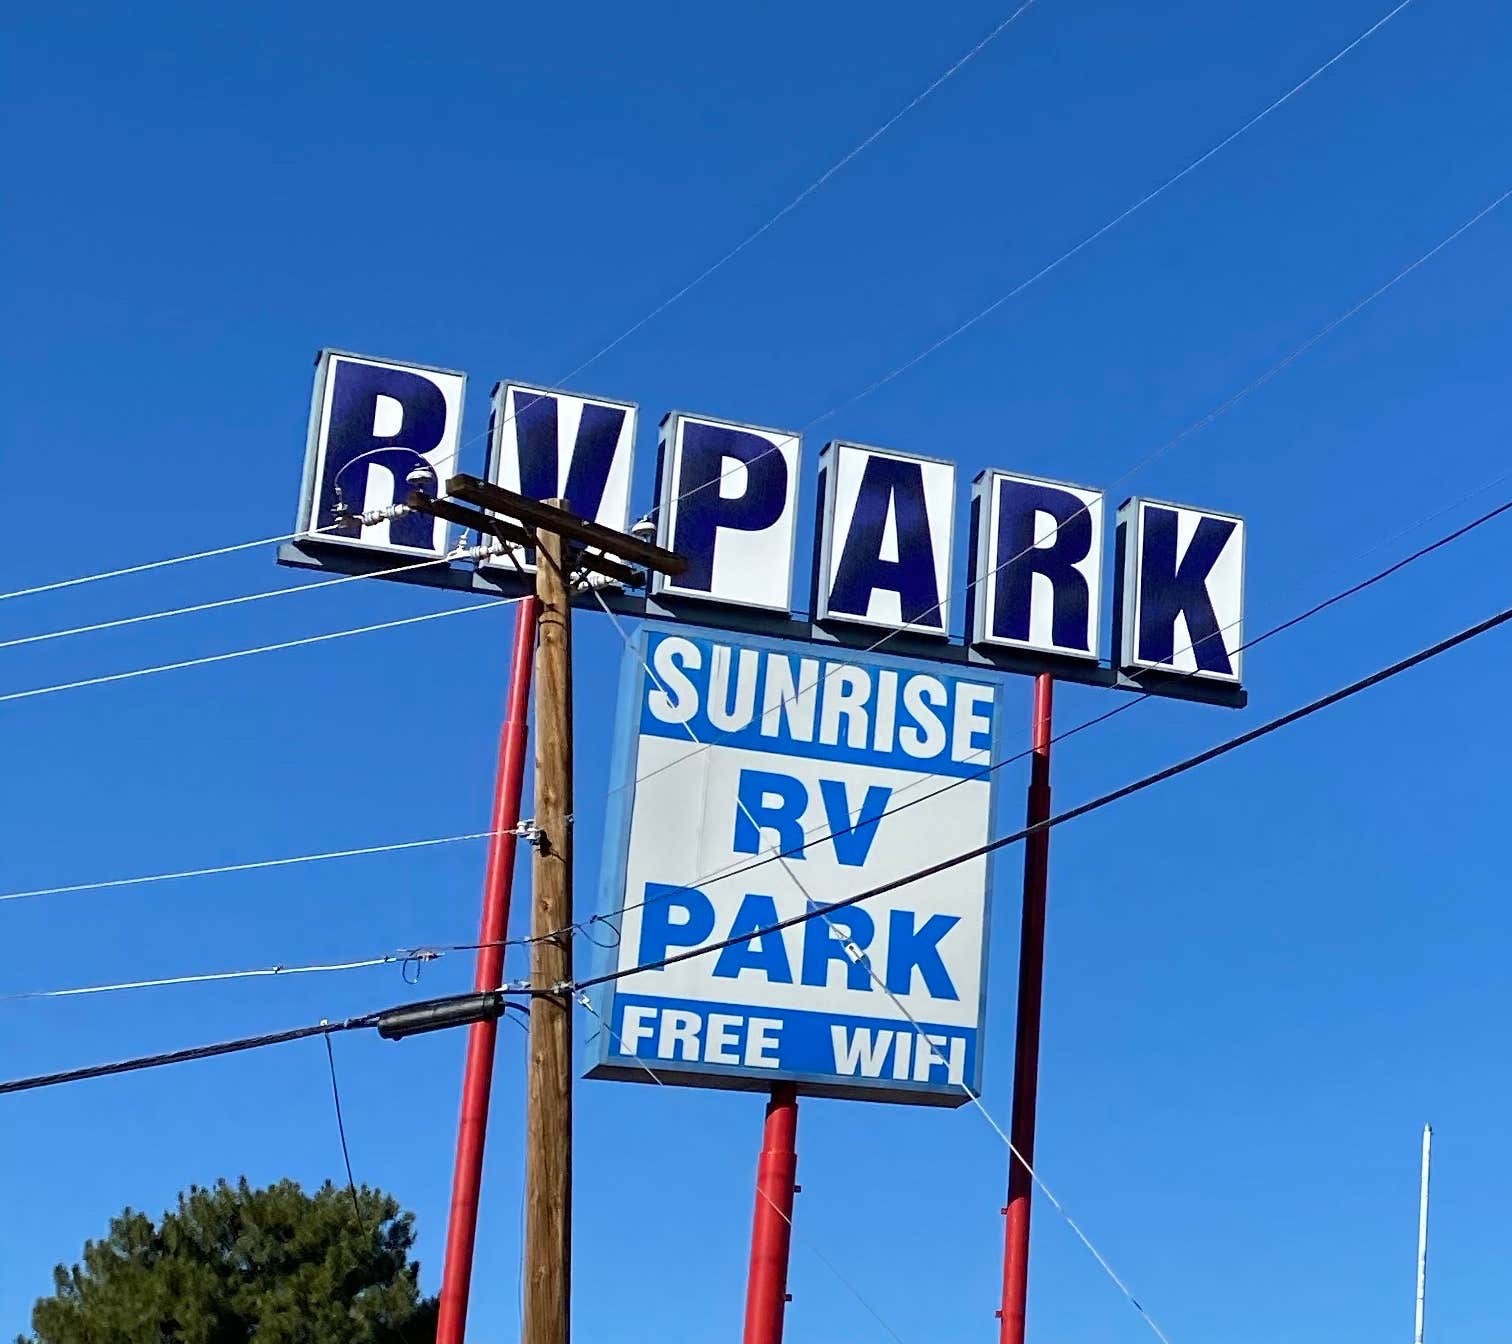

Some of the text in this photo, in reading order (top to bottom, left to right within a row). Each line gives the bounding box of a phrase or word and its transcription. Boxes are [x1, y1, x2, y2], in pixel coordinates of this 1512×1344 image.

[648, 636, 995, 766] SUNRISE
[733, 769, 893, 867] RV
[638, 882, 961, 1001] PARK
[619, 1006, 965, 1085] FREE WIFI
